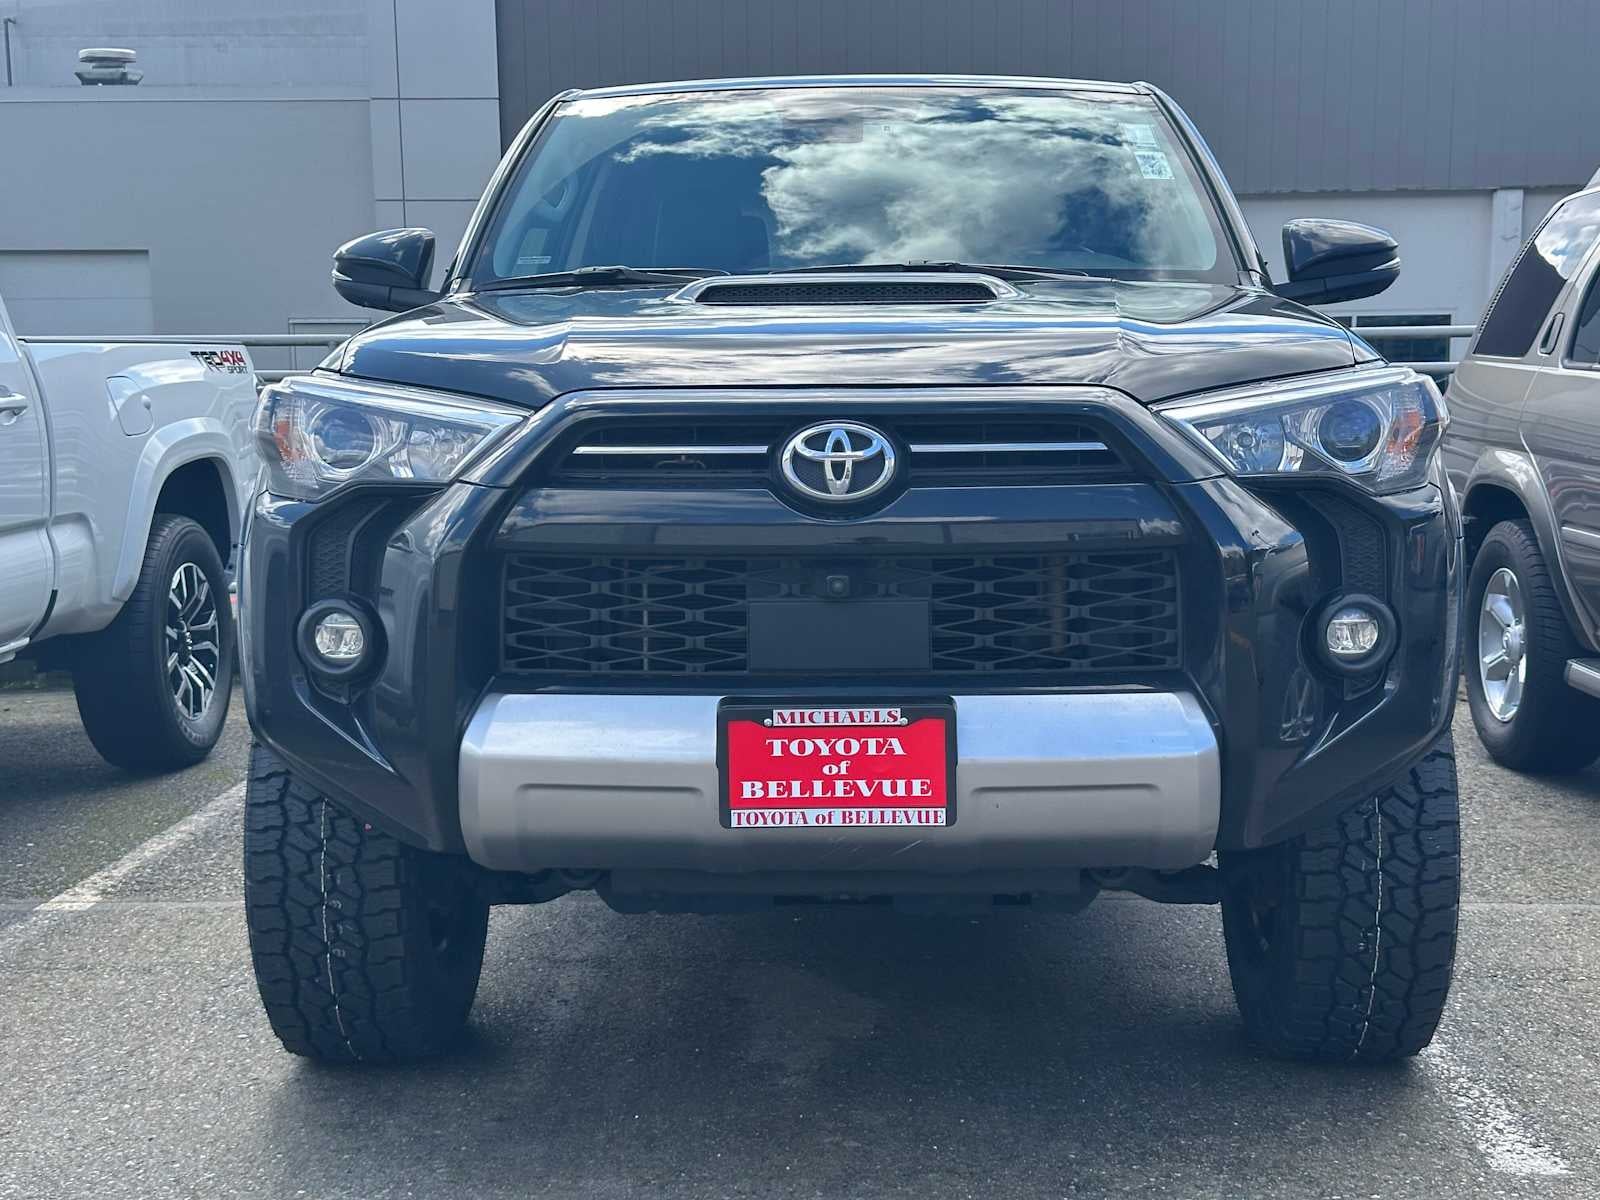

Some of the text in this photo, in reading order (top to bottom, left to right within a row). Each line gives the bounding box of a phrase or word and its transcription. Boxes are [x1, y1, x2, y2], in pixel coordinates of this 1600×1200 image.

[227, 365, 249, 374] SPORT
[775, 709, 900, 724] MICHAELS
[766, 737, 907, 756] TOYOTA
[822, 760, 851, 775] of
[740, 779, 932, 799] BELLEVUE
[732, 809, 945, 826] TOYOTA of BELLEVUE
